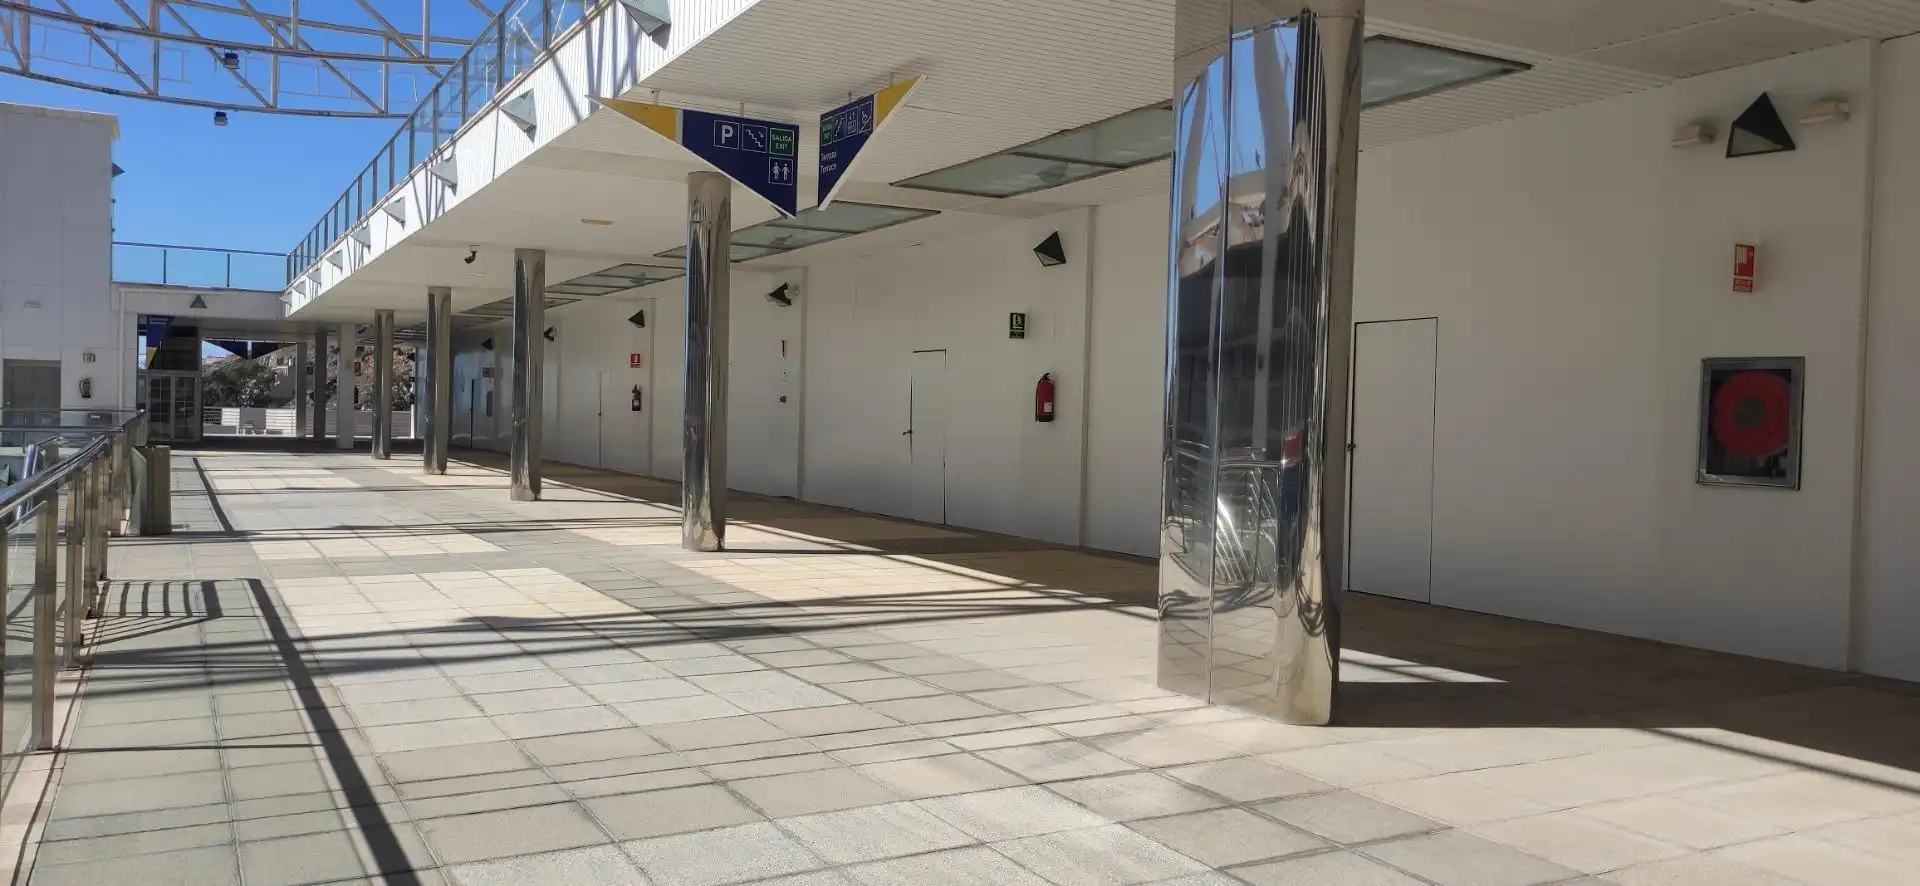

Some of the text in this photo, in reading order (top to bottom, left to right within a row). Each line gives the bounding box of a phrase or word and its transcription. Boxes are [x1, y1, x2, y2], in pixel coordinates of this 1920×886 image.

[721, 124, 734, 144] P
[771, 134, 792, 142] SALIDA
[775, 142, 788, 150] EXIT
